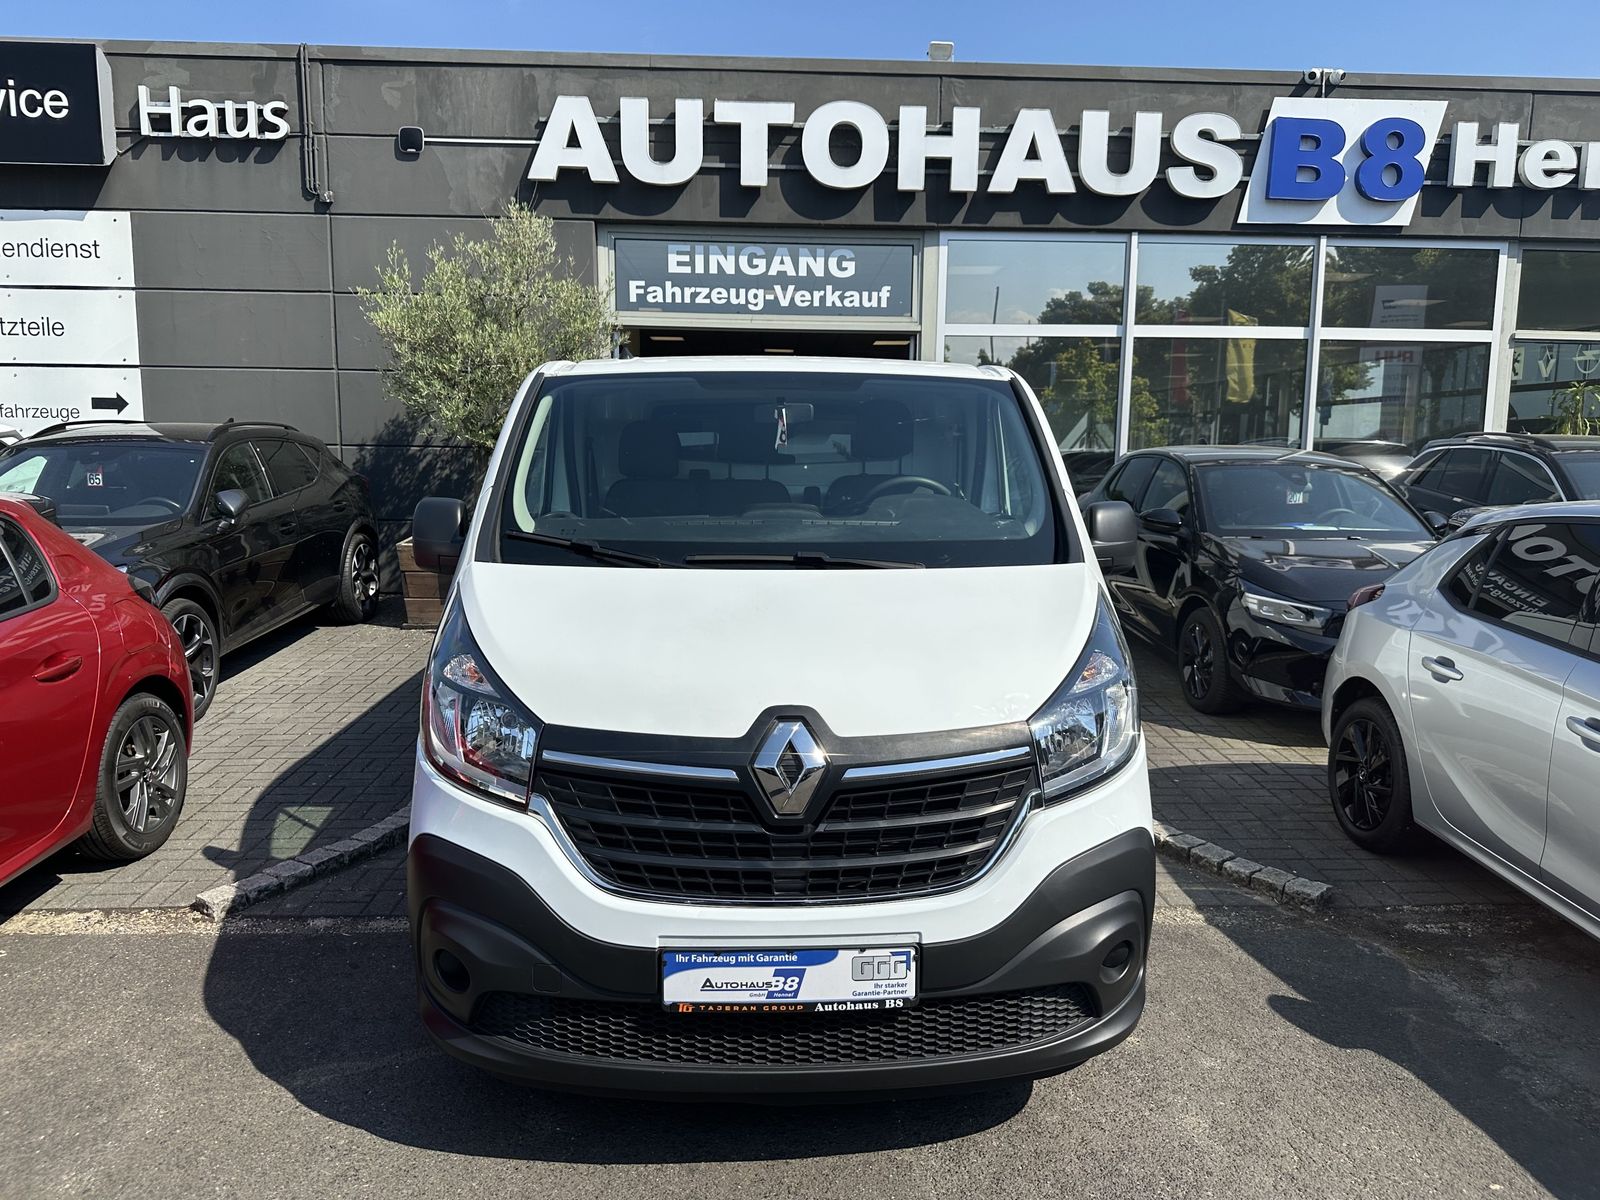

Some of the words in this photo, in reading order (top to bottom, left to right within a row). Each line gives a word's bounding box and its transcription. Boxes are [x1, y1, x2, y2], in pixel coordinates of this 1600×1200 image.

[137, 85, 290, 140] Haus
[527, 95, 1244, 199] AUTOHAUS
[1266, 117, 1427, 202] B8
[666, 244, 857, 278] EINGANG
[628, 280, 892, 311] Fahrzeug-Verkauf
[88, 473, 101, 485] 65
[675, 954, 689, 963] Ihr
[691, 954, 736, 965] Fahrzeug
[738, 953, 755, 962] mit
[756, 953, 798, 962] Garantie
[852, 989, 908, 997] Garantie-Partner
[814, 1001, 879, 1012] Autohaus
[884, 998, 904, 1008] B8
